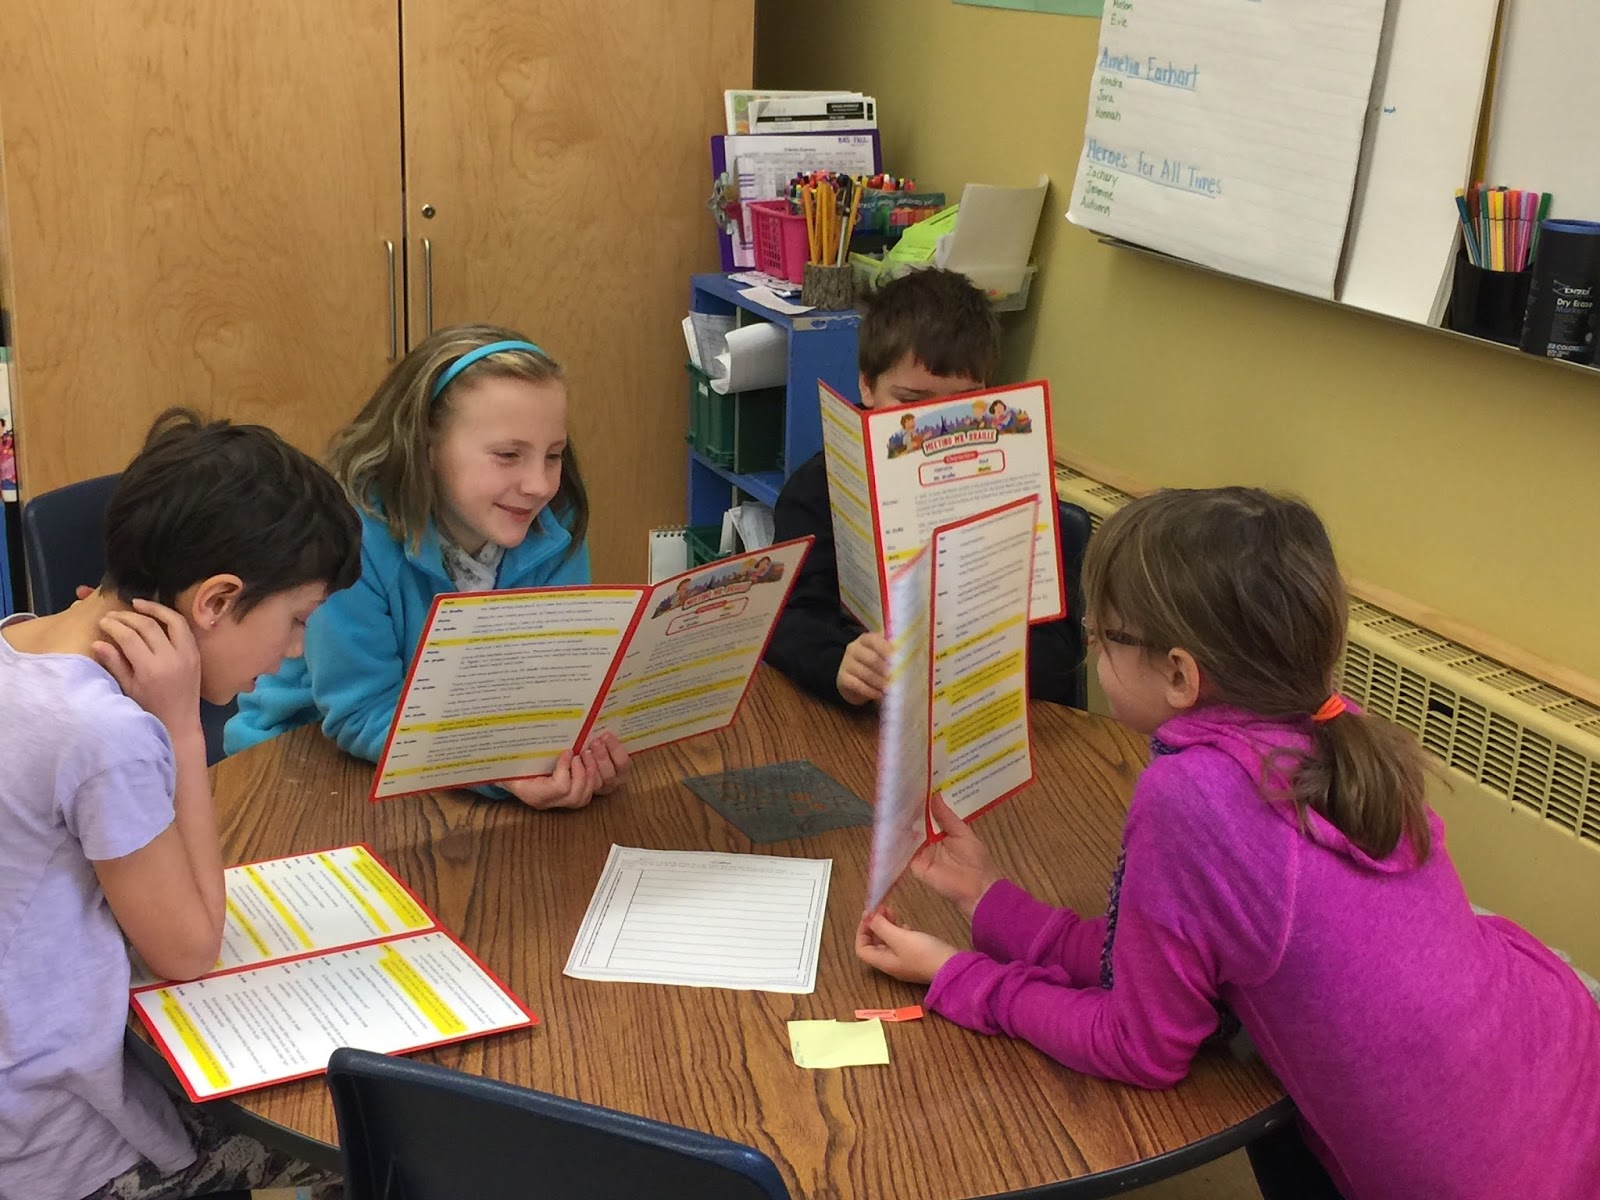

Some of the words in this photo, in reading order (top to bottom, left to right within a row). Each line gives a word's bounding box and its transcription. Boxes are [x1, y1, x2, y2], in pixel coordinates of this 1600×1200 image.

[1099, 46, 1140, 76] Amelia
[1146, 57, 1200, 89] Earhart
[1086, 138, 1128, 169] Heroes
[1137, 150, 1155, 176] for
[1161, 158, 1181, 183] All
[1188, 166, 1222, 194] Times
[1556, 297, 1571, 308] Dry
[1573, 299, 1593, 308] Erase
[925, 437, 953, 452] MEETING
